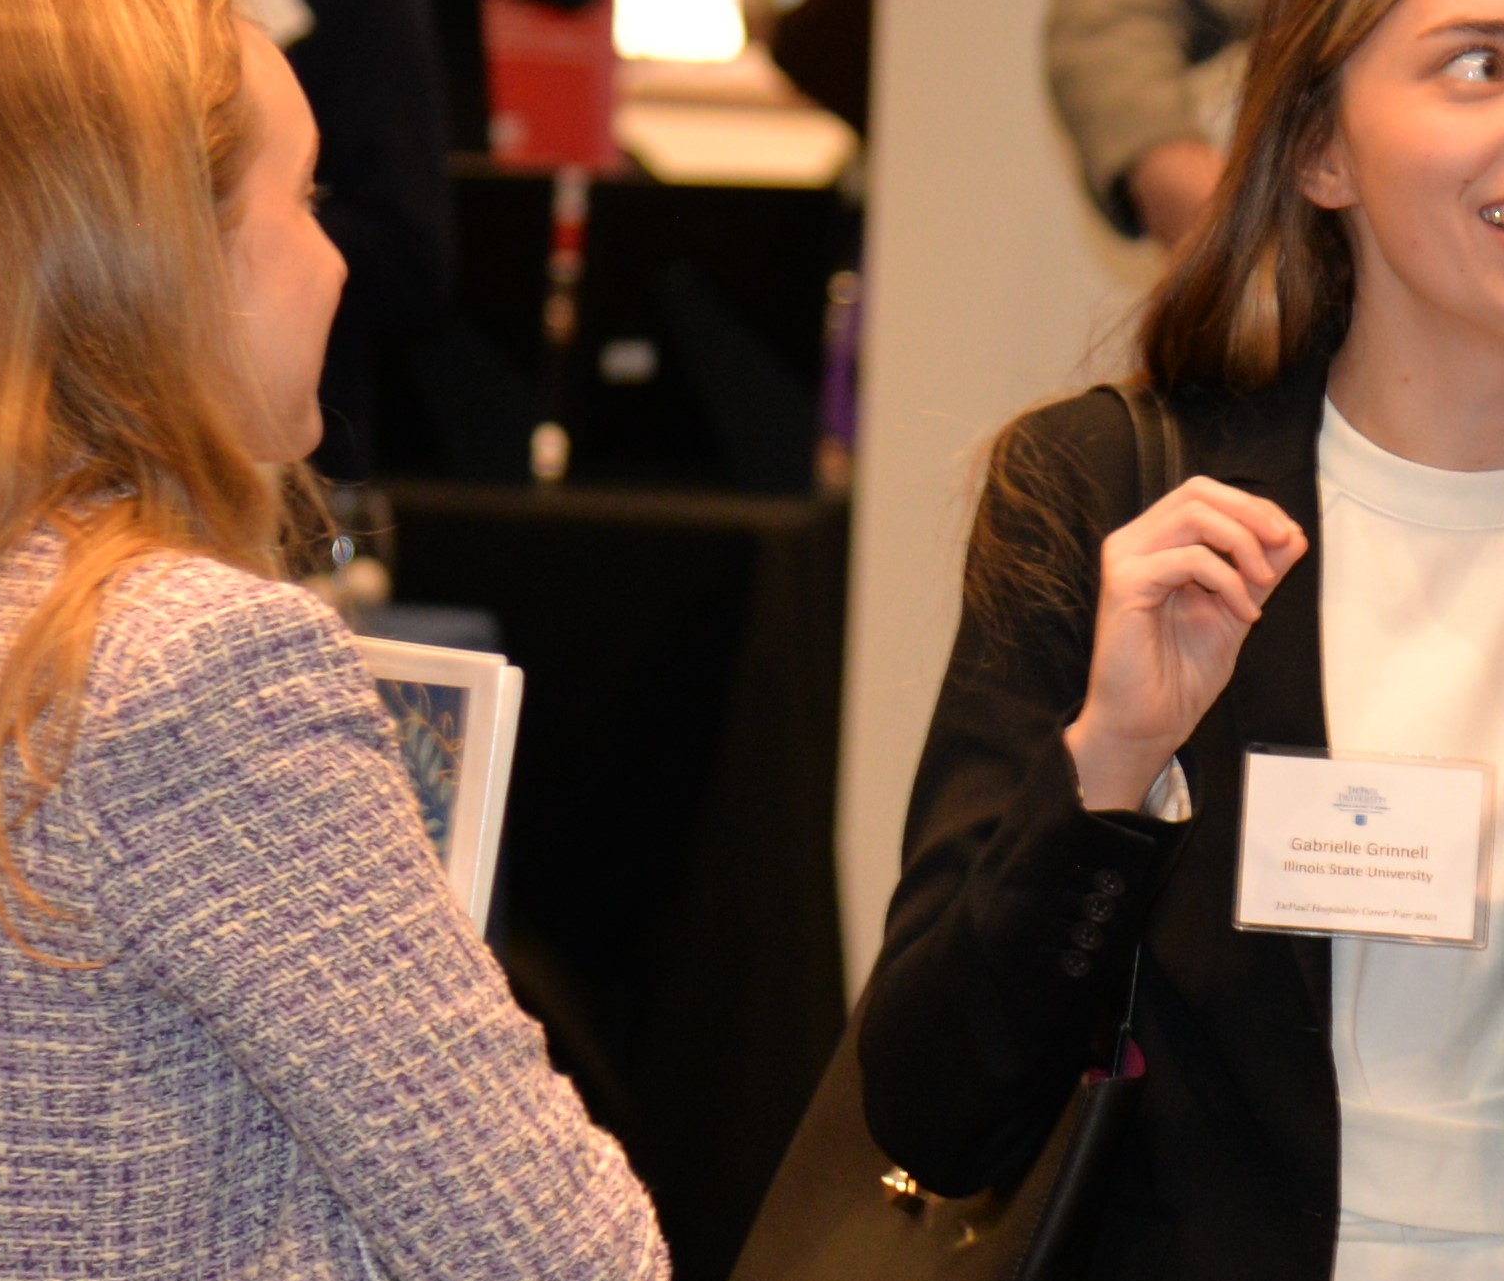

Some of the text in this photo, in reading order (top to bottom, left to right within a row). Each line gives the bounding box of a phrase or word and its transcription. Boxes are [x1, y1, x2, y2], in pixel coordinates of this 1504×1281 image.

[1291, 837, 1429, 860] Gabrielle Grinnell
[1283, 861, 1434, 884] Illinois State University
